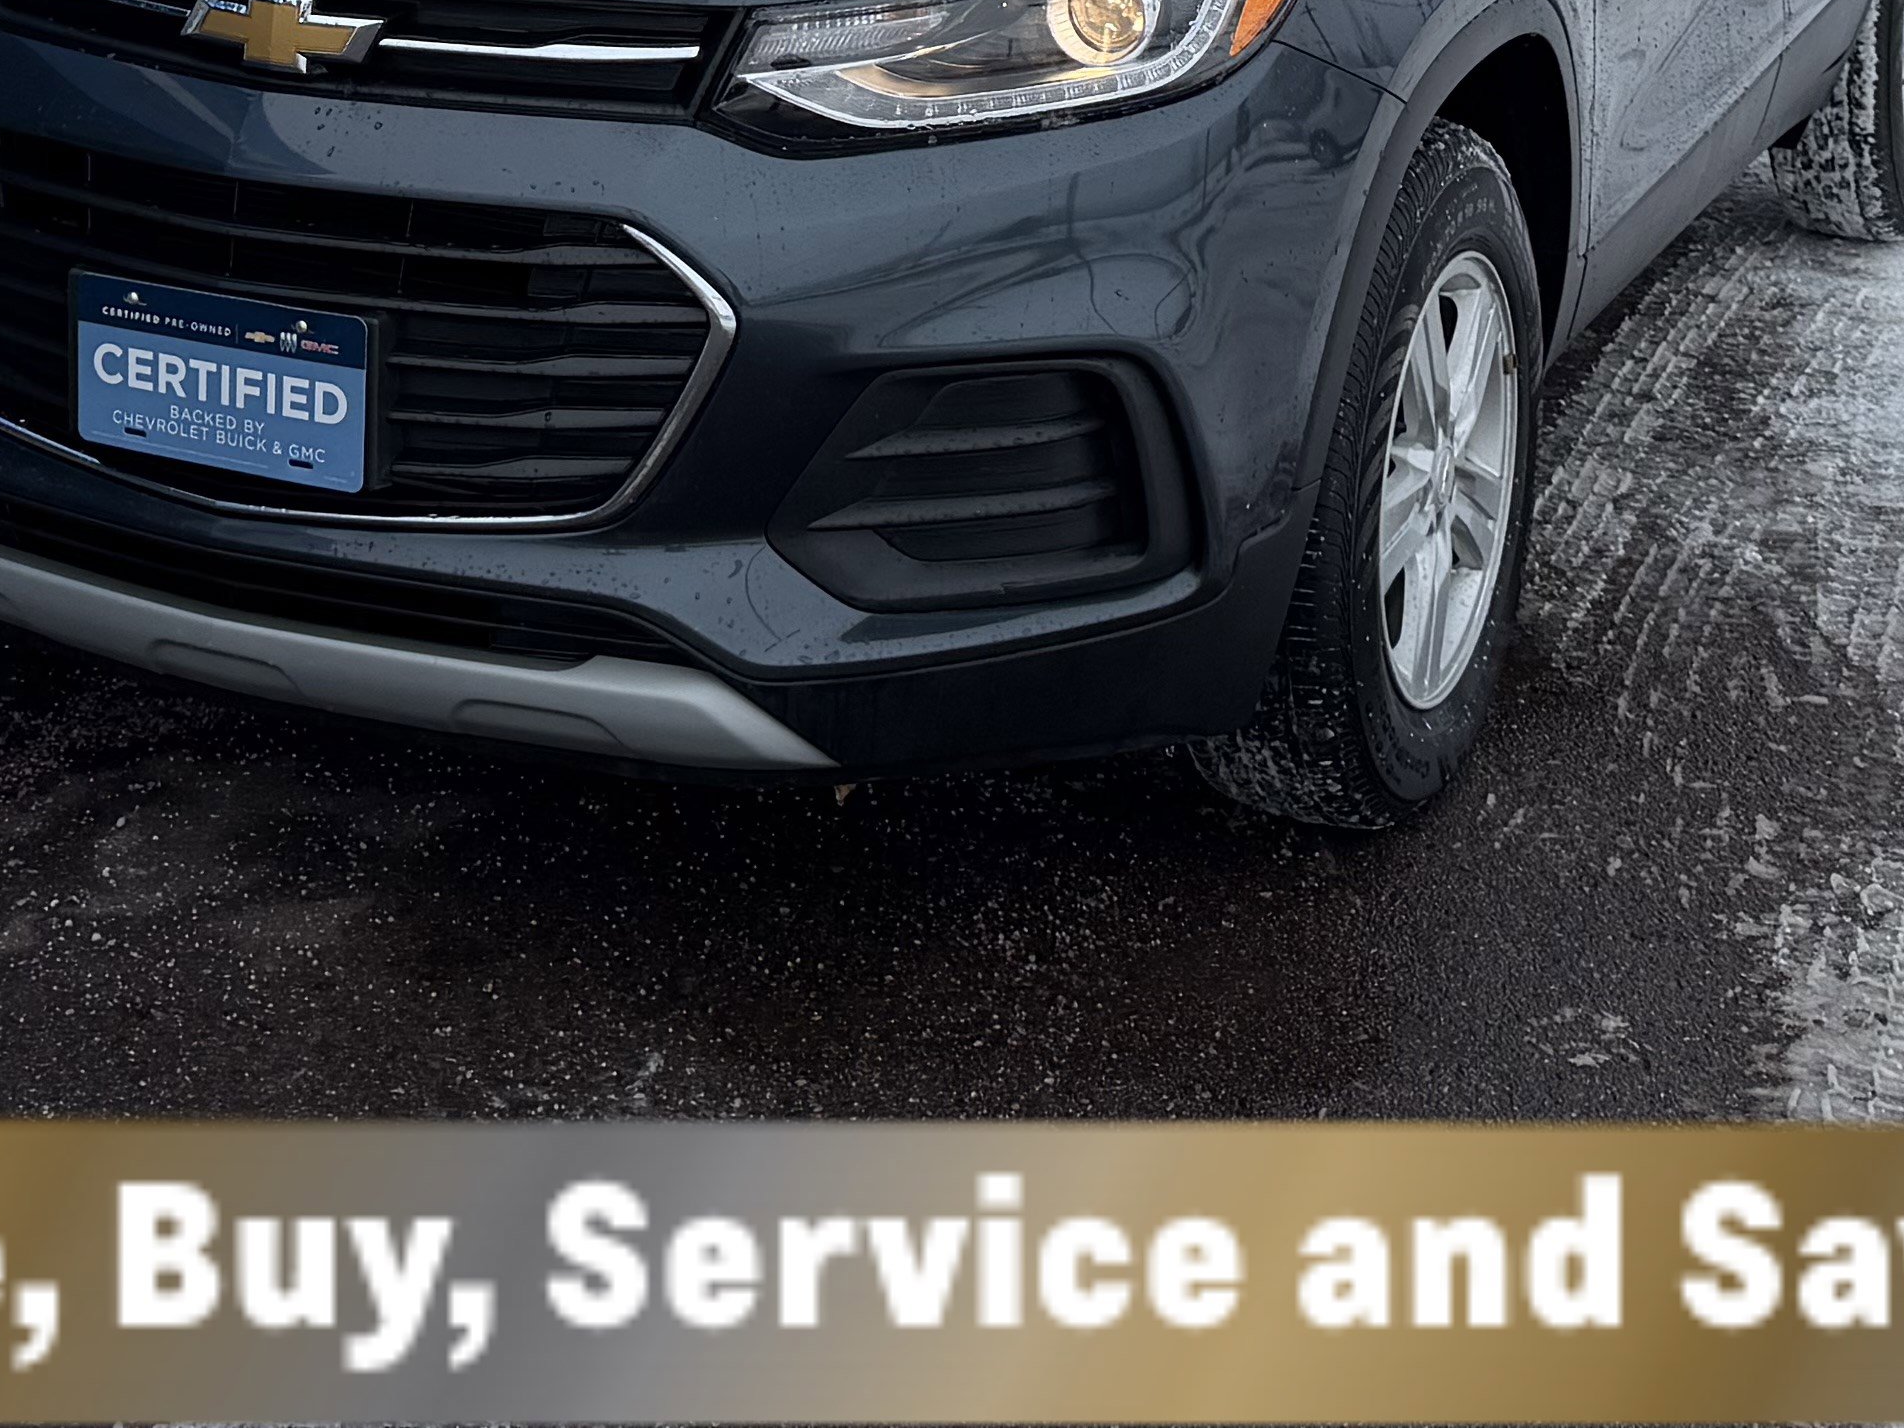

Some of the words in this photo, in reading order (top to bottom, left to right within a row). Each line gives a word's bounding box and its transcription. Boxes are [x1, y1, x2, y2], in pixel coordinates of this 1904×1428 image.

[102, 305, 161, 326] CERTIFIED
[164, 316, 232, 338] PRE-OWNED
[93, 342, 349, 426] CERTIFIED
[112, 409, 209, 442] CHEVROLET
[216, 430, 267, 453] BUICK
[272, 441, 283, 456] &
[288, 443, 326, 464] GMC
[170, 405, 237, 431] BACKED
[244, 419, 265, 435] BY
